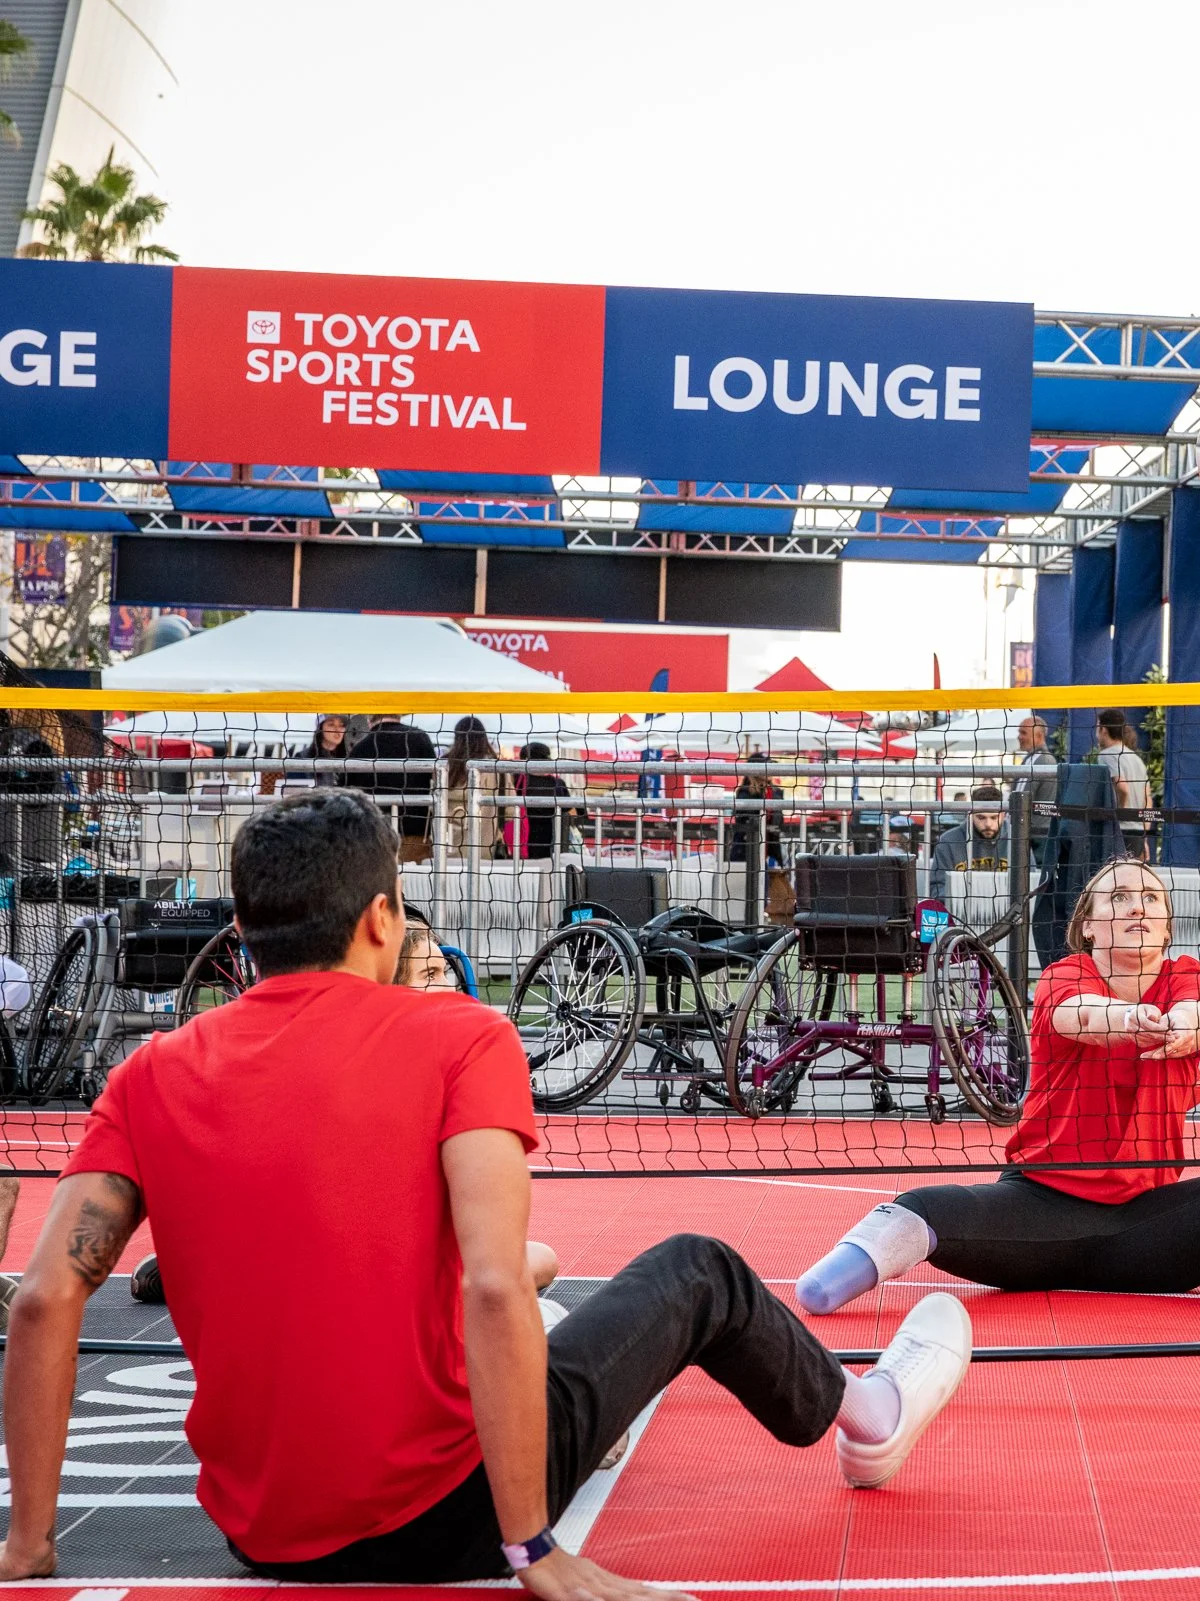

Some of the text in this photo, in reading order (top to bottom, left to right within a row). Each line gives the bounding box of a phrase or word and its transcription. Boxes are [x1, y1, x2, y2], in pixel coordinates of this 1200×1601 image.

[295, 312, 480, 353] TOYOTA
[0, 329, 97, 388] GE
[246, 350, 415, 388] SPORTS
[673, 355, 981, 421] LOUNGE
[322, 390, 527, 431] FESTIVAL
[153, 901, 193, 909] ABILITY
[161, 909, 211, 917] EQUIPPED
